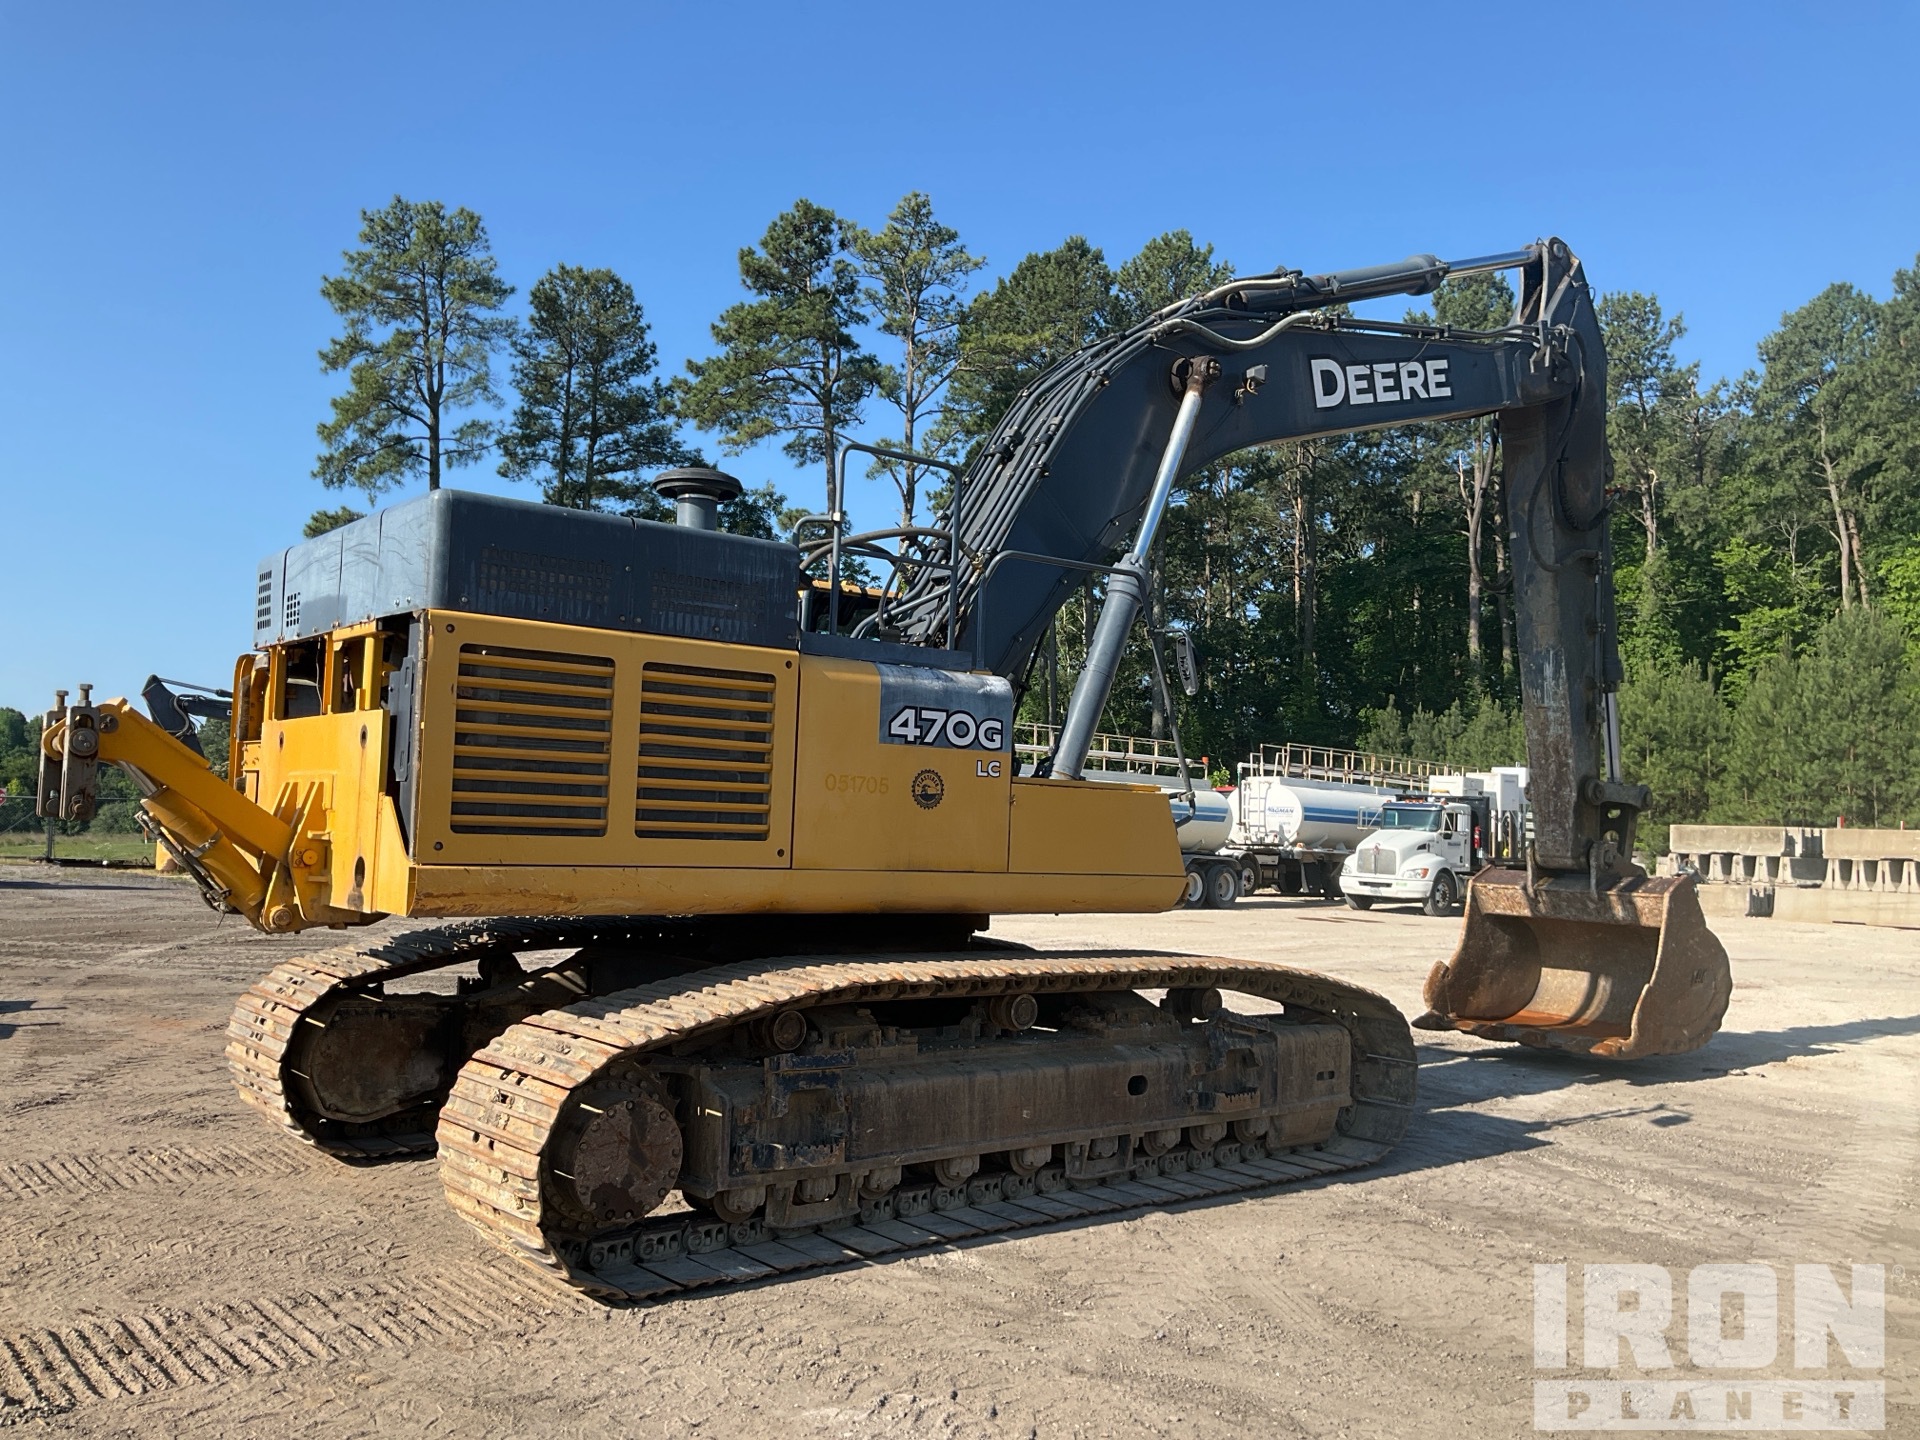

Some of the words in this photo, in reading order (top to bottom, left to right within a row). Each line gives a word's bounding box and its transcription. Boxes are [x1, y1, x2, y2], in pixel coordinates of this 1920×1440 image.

[1310, 358, 1452, 408] DEERE
[889, 706, 1003, 751] 470G
[824, 773, 889, 794] 051705
[976, 759, 1001, 778] LC
